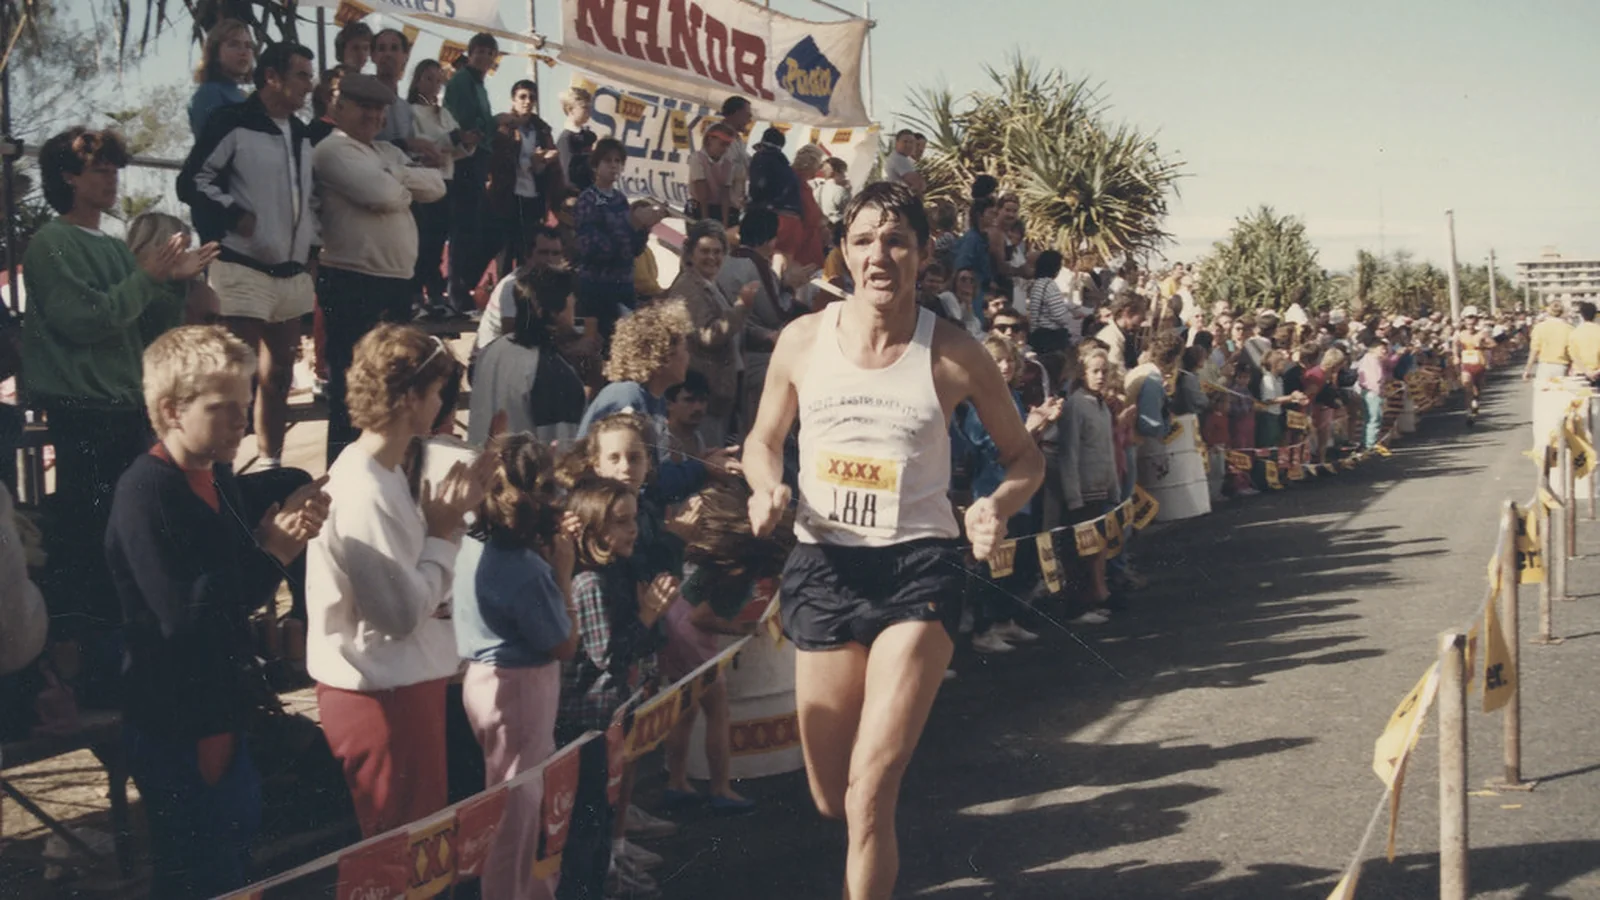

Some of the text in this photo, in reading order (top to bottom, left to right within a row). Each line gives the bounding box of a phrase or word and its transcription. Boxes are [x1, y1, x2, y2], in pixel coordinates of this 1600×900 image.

[573, 0, 776, 102] NANDA
[590, 86, 712, 163] SEIK
[828, 459, 882, 480] XXXX
[828, 488, 877, 528] 188
